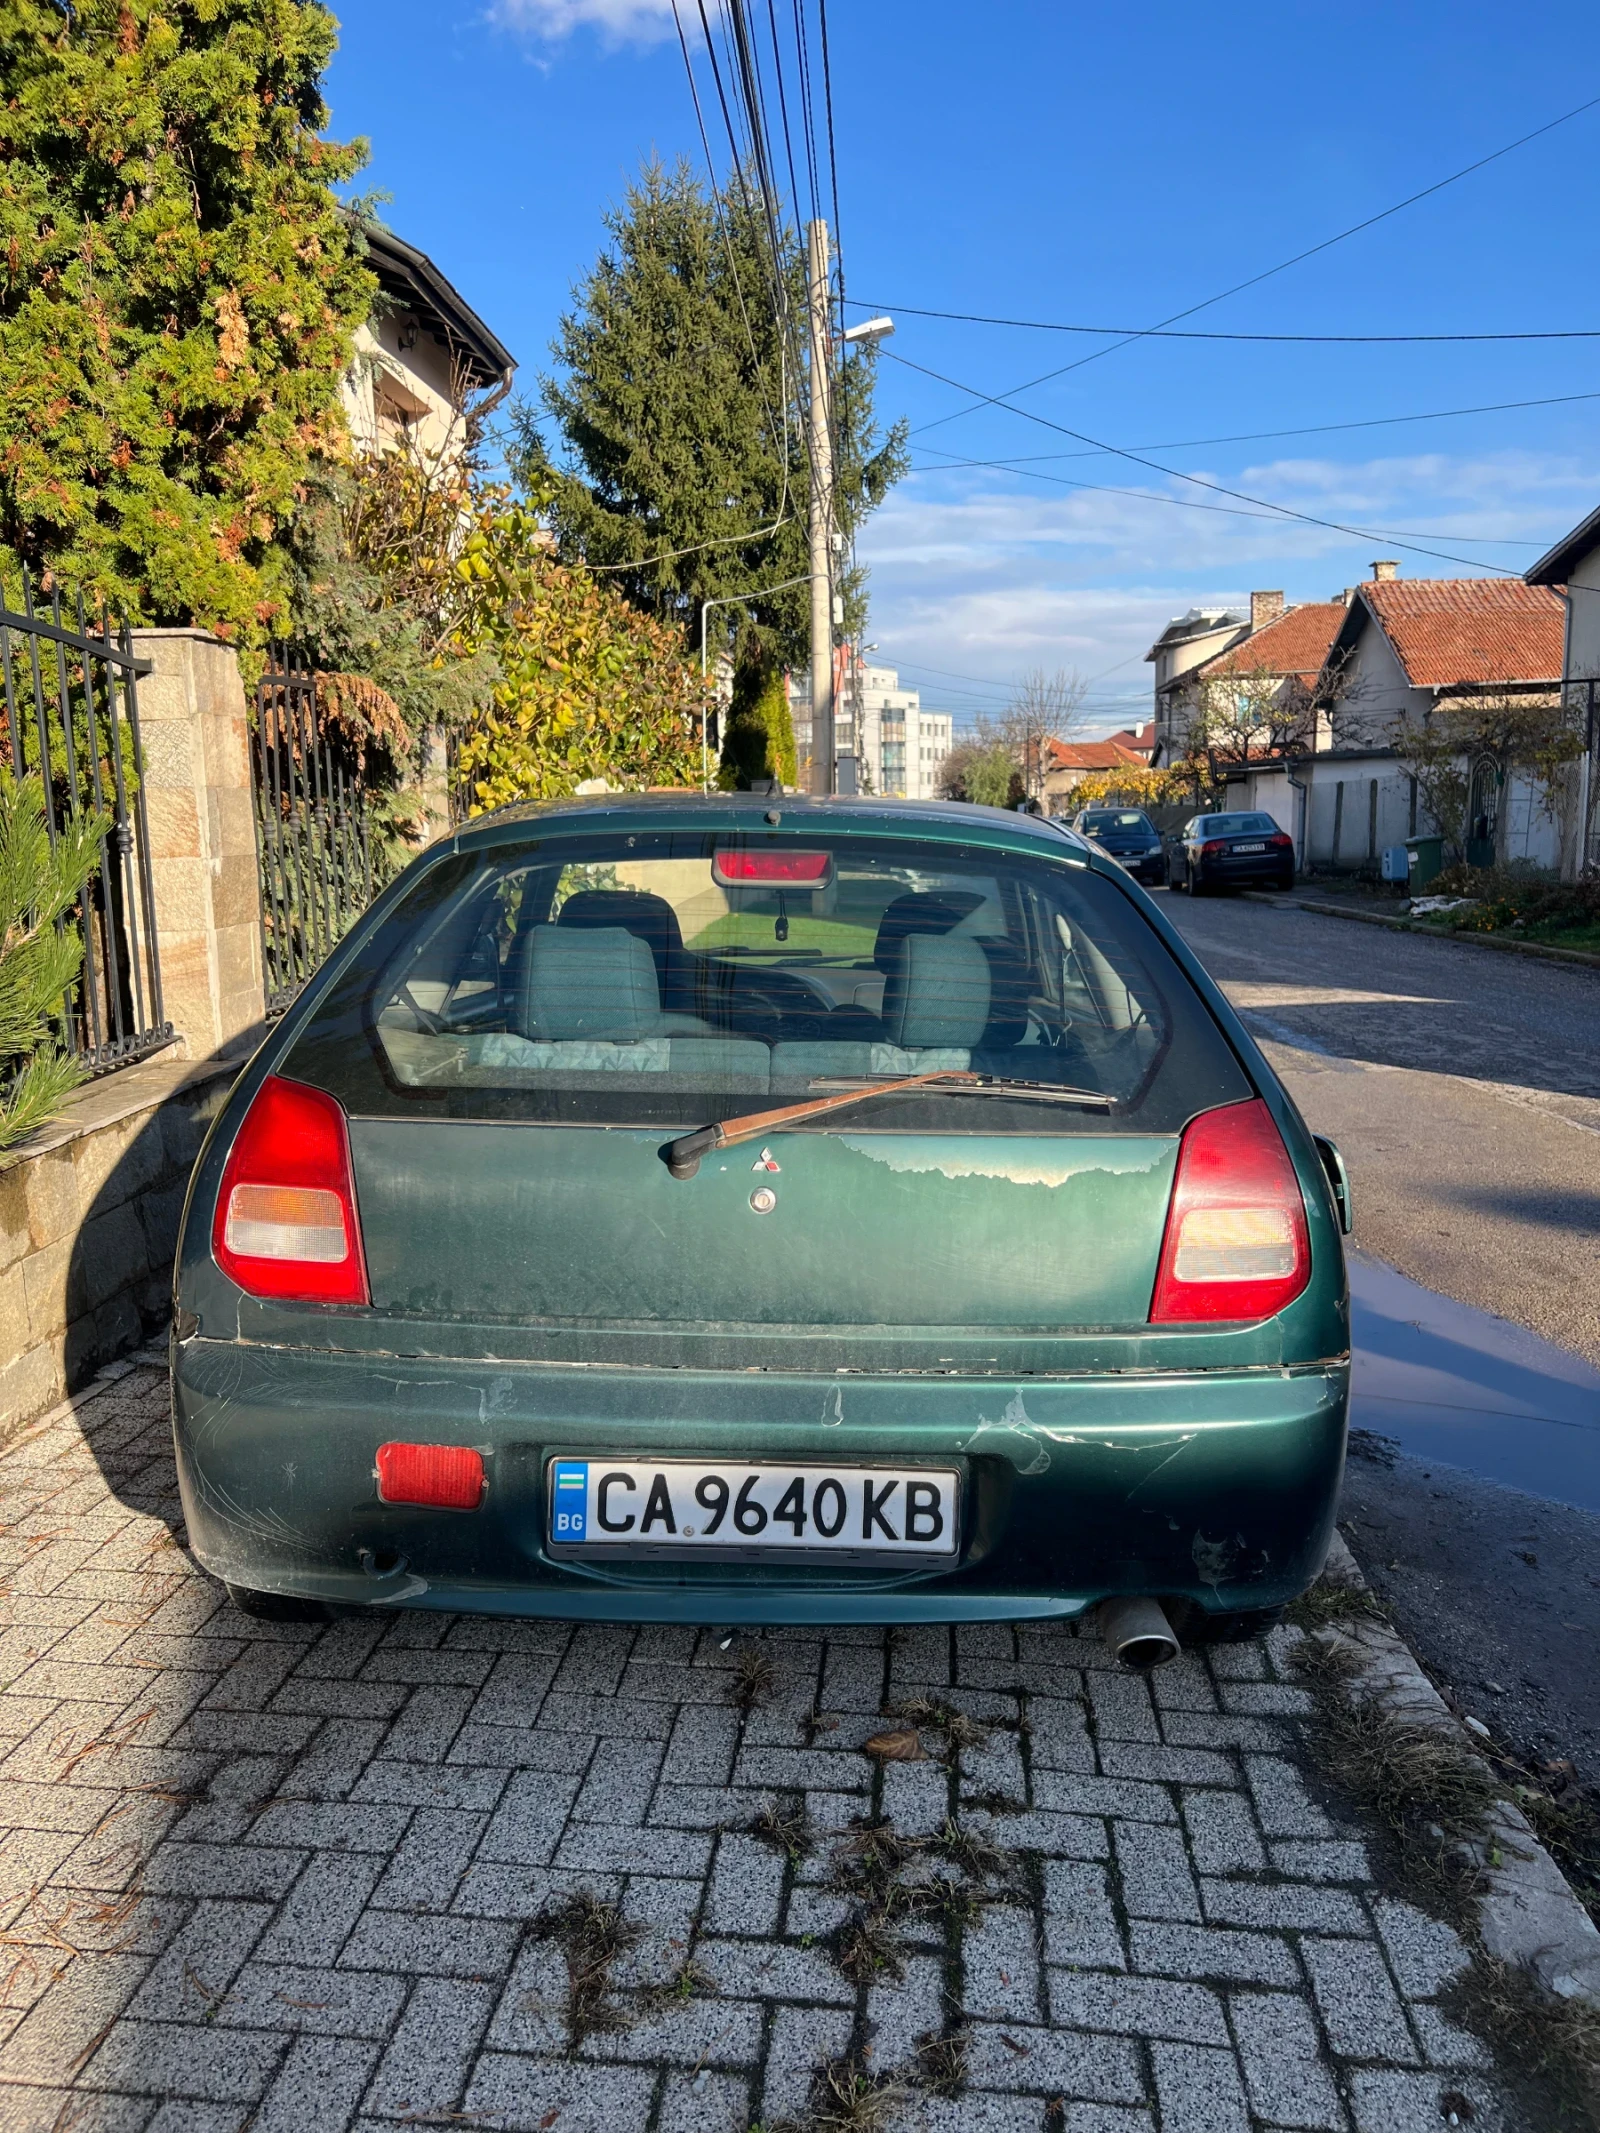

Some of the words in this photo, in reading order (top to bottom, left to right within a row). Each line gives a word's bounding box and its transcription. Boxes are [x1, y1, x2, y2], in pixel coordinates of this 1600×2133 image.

[557, 1513, 583, 1531] BG
[597, 1472, 677, 1534] CA
[694, 1475, 848, 1539] 9640
[862, 1479, 944, 1542] KB
